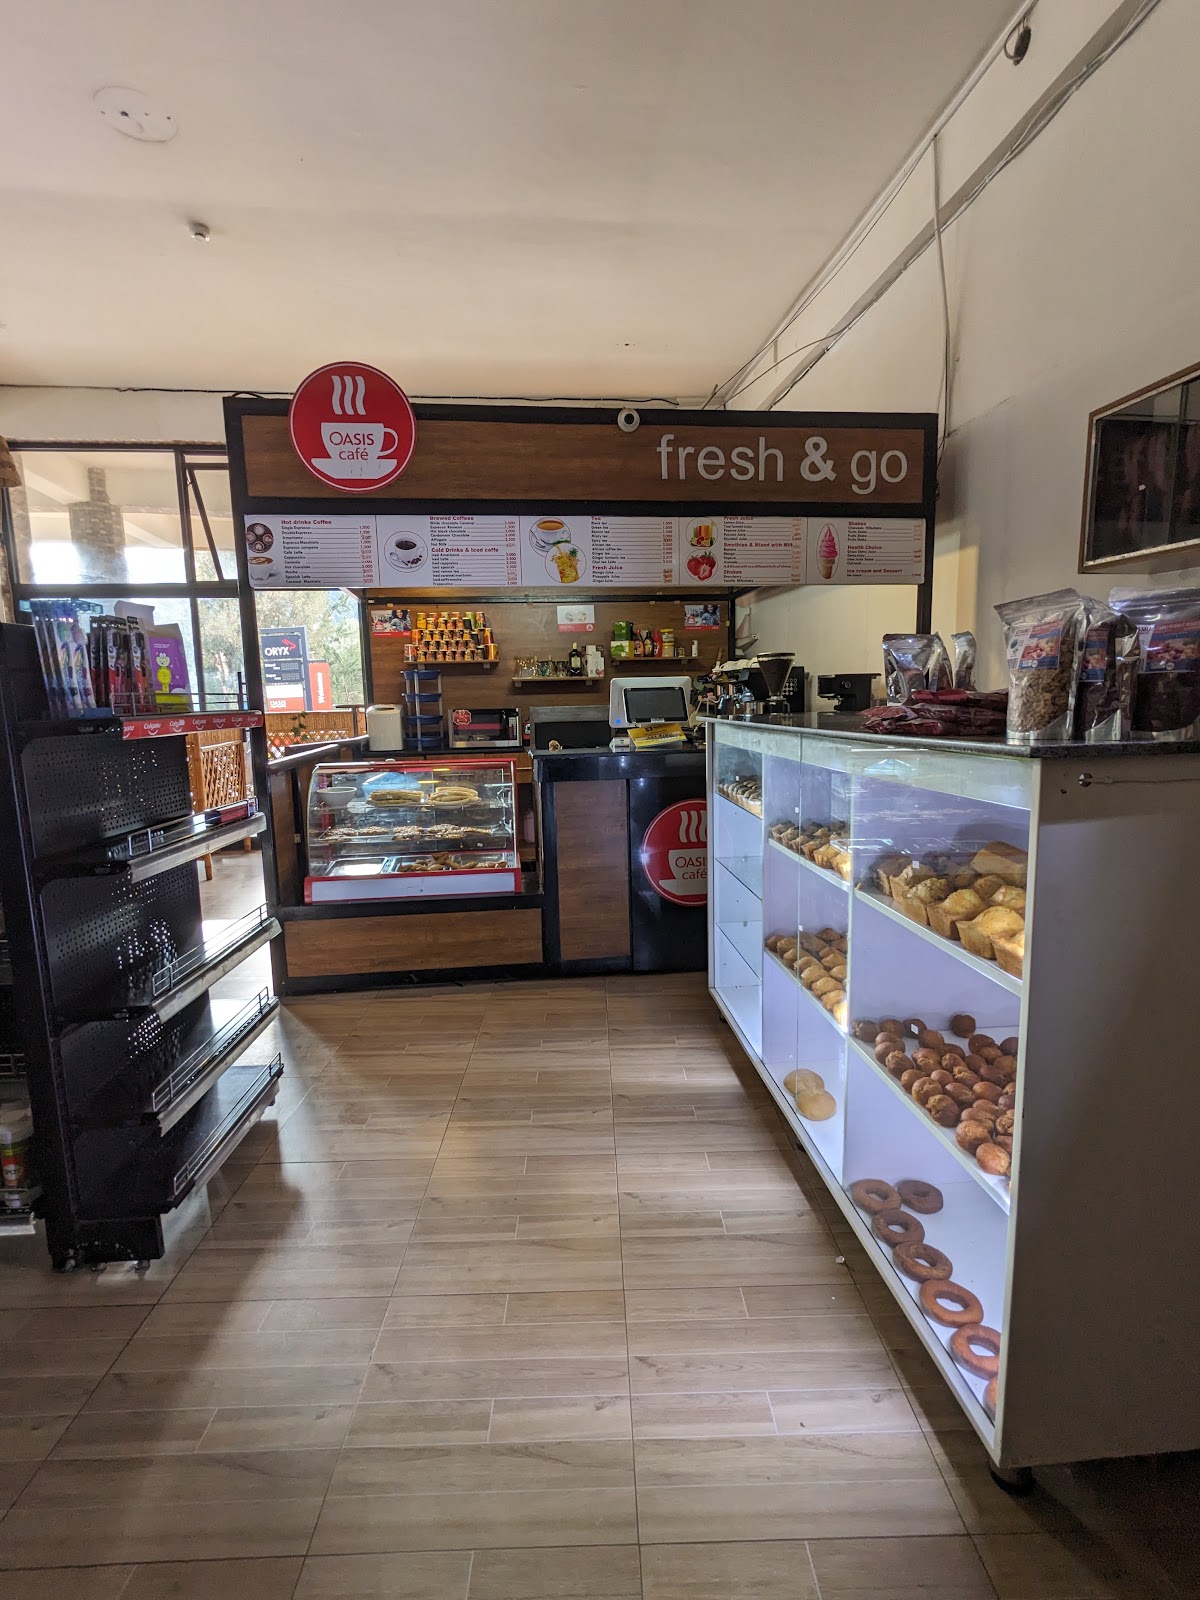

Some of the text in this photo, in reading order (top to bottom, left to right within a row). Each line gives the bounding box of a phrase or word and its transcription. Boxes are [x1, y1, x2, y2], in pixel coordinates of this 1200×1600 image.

[329, 431, 375, 447] OASIS
[338, 447, 369, 461] café
[656, 433, 908, 495] fresh & go
[264, 646, 290, 656] ORYX
[143, 722, 162, 730] Colgate
[192, 718, 207, 726] Colgate
[212, 716, 227, 725] Colgate
[675, 856, 708, 868] OASI
[682, 868, 708, 880] café
